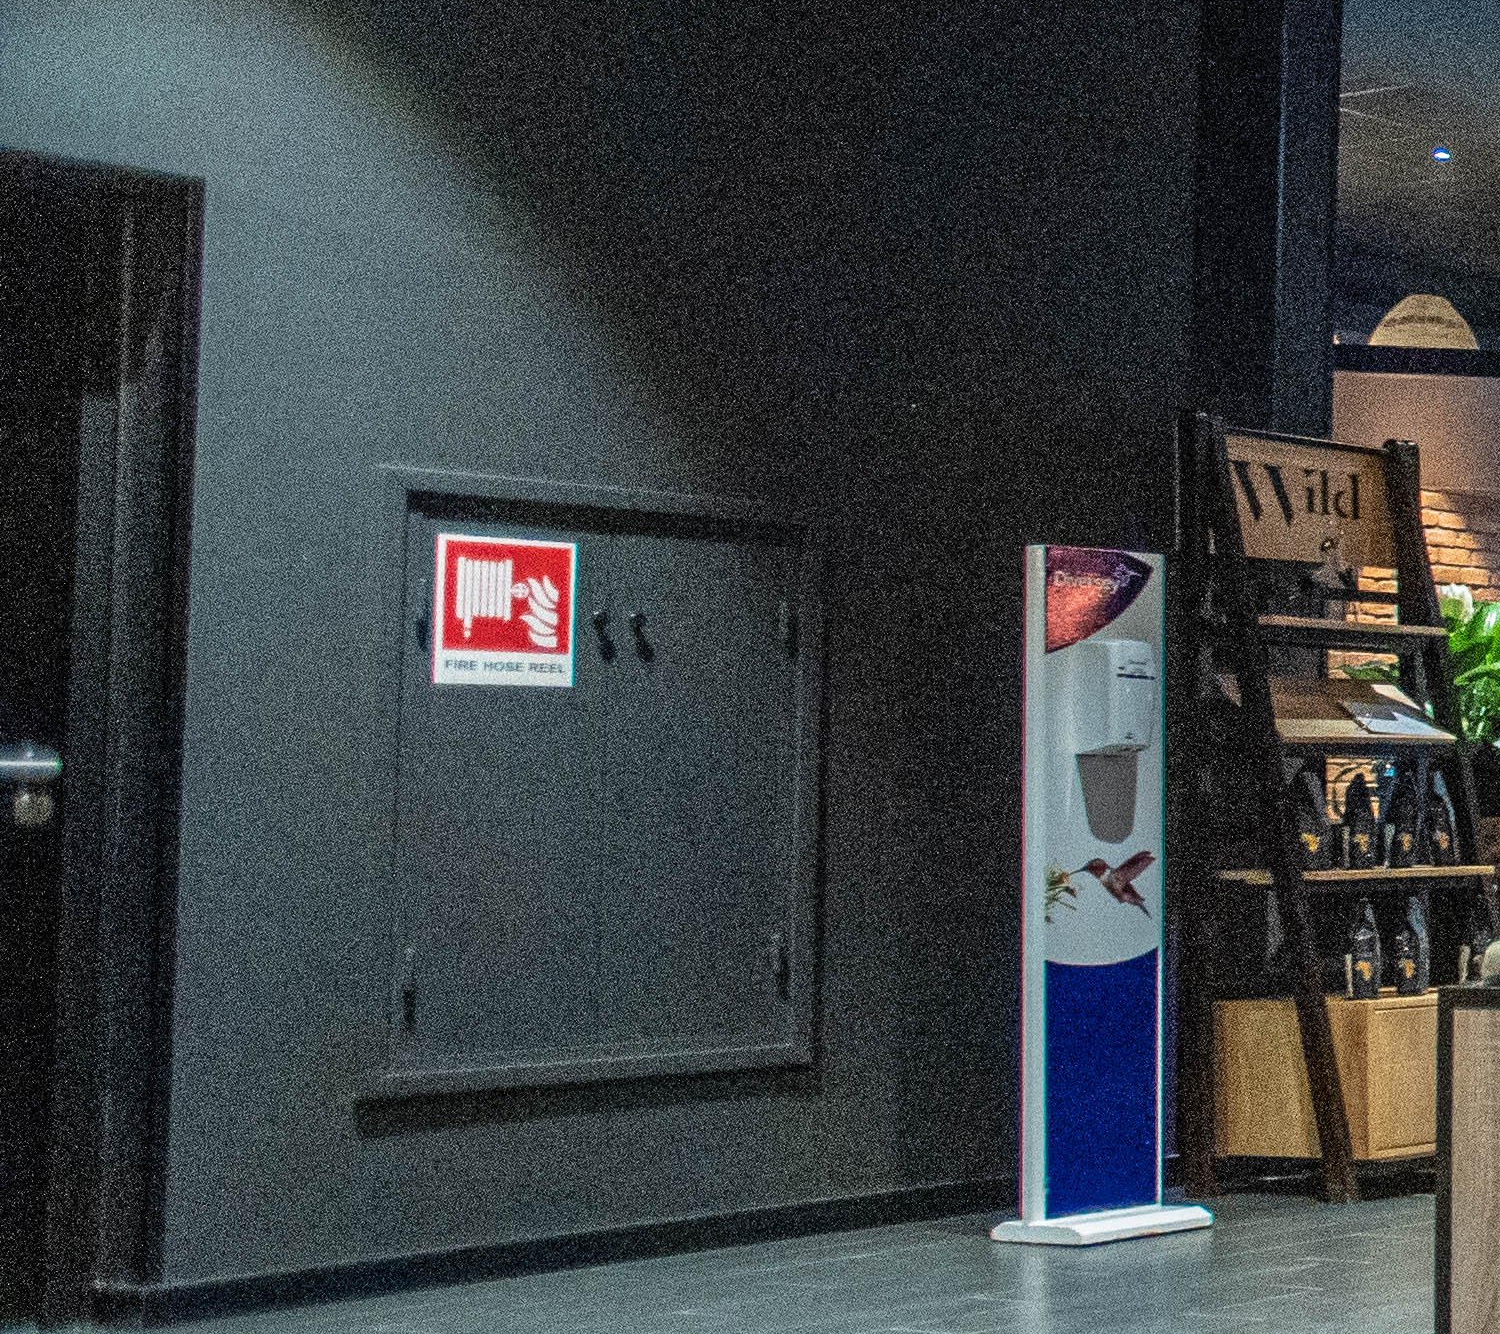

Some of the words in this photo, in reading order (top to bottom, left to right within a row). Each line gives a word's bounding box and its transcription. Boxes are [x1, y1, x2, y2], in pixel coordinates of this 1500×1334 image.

[1228, 460, 1360, 526] Wild
[445, 659, 478, 671] FIRE
[483, 660, 525, 672] HOSE
[528, 662, 566, 674] REEL
